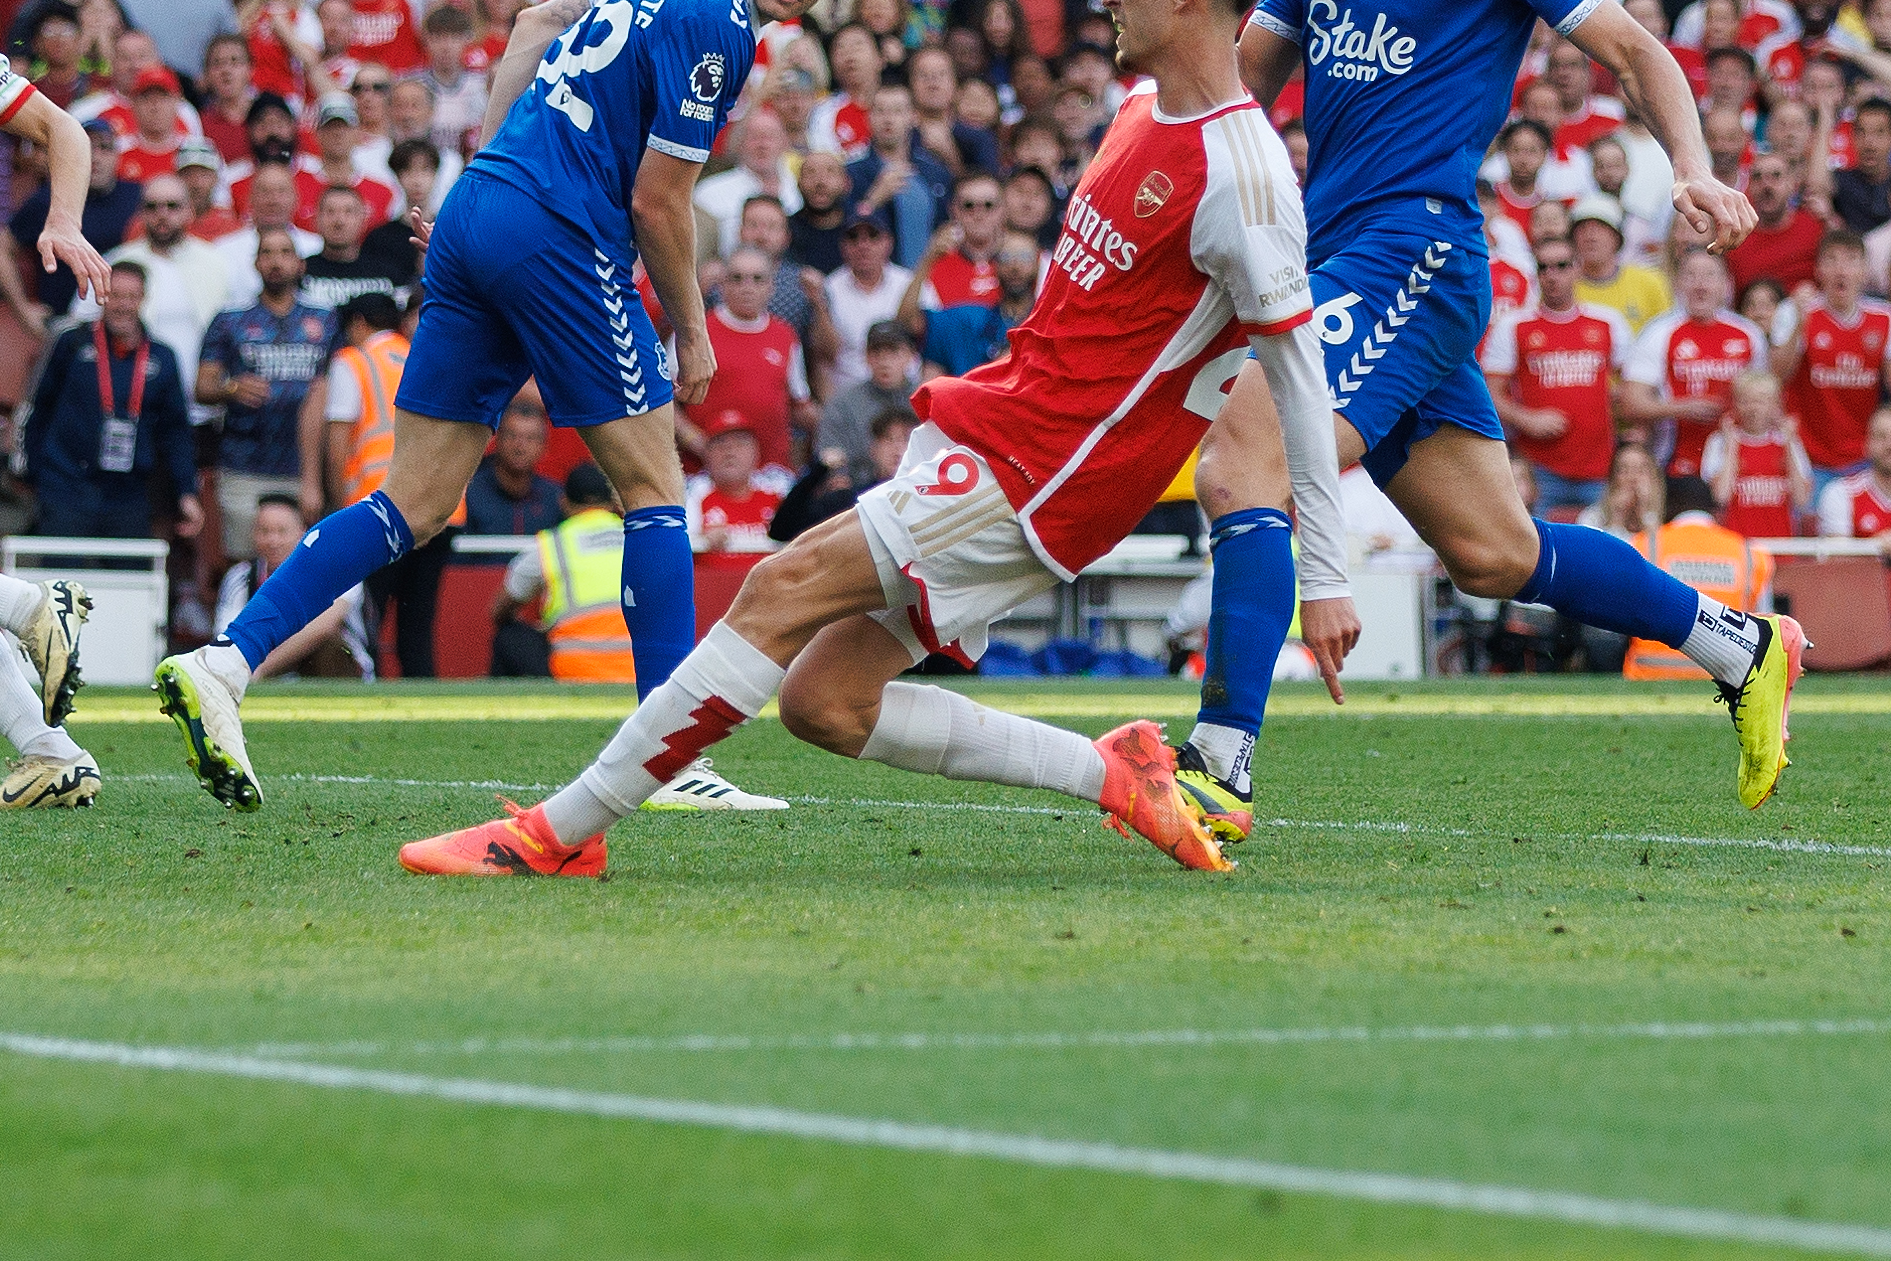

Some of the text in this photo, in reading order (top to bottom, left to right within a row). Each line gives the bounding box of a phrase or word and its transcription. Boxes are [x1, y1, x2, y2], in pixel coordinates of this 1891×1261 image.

[1327, 61, 1379, 82] .com
[1311, 291, 1364, 346] 6
[914, 452, 980, 496] 9
